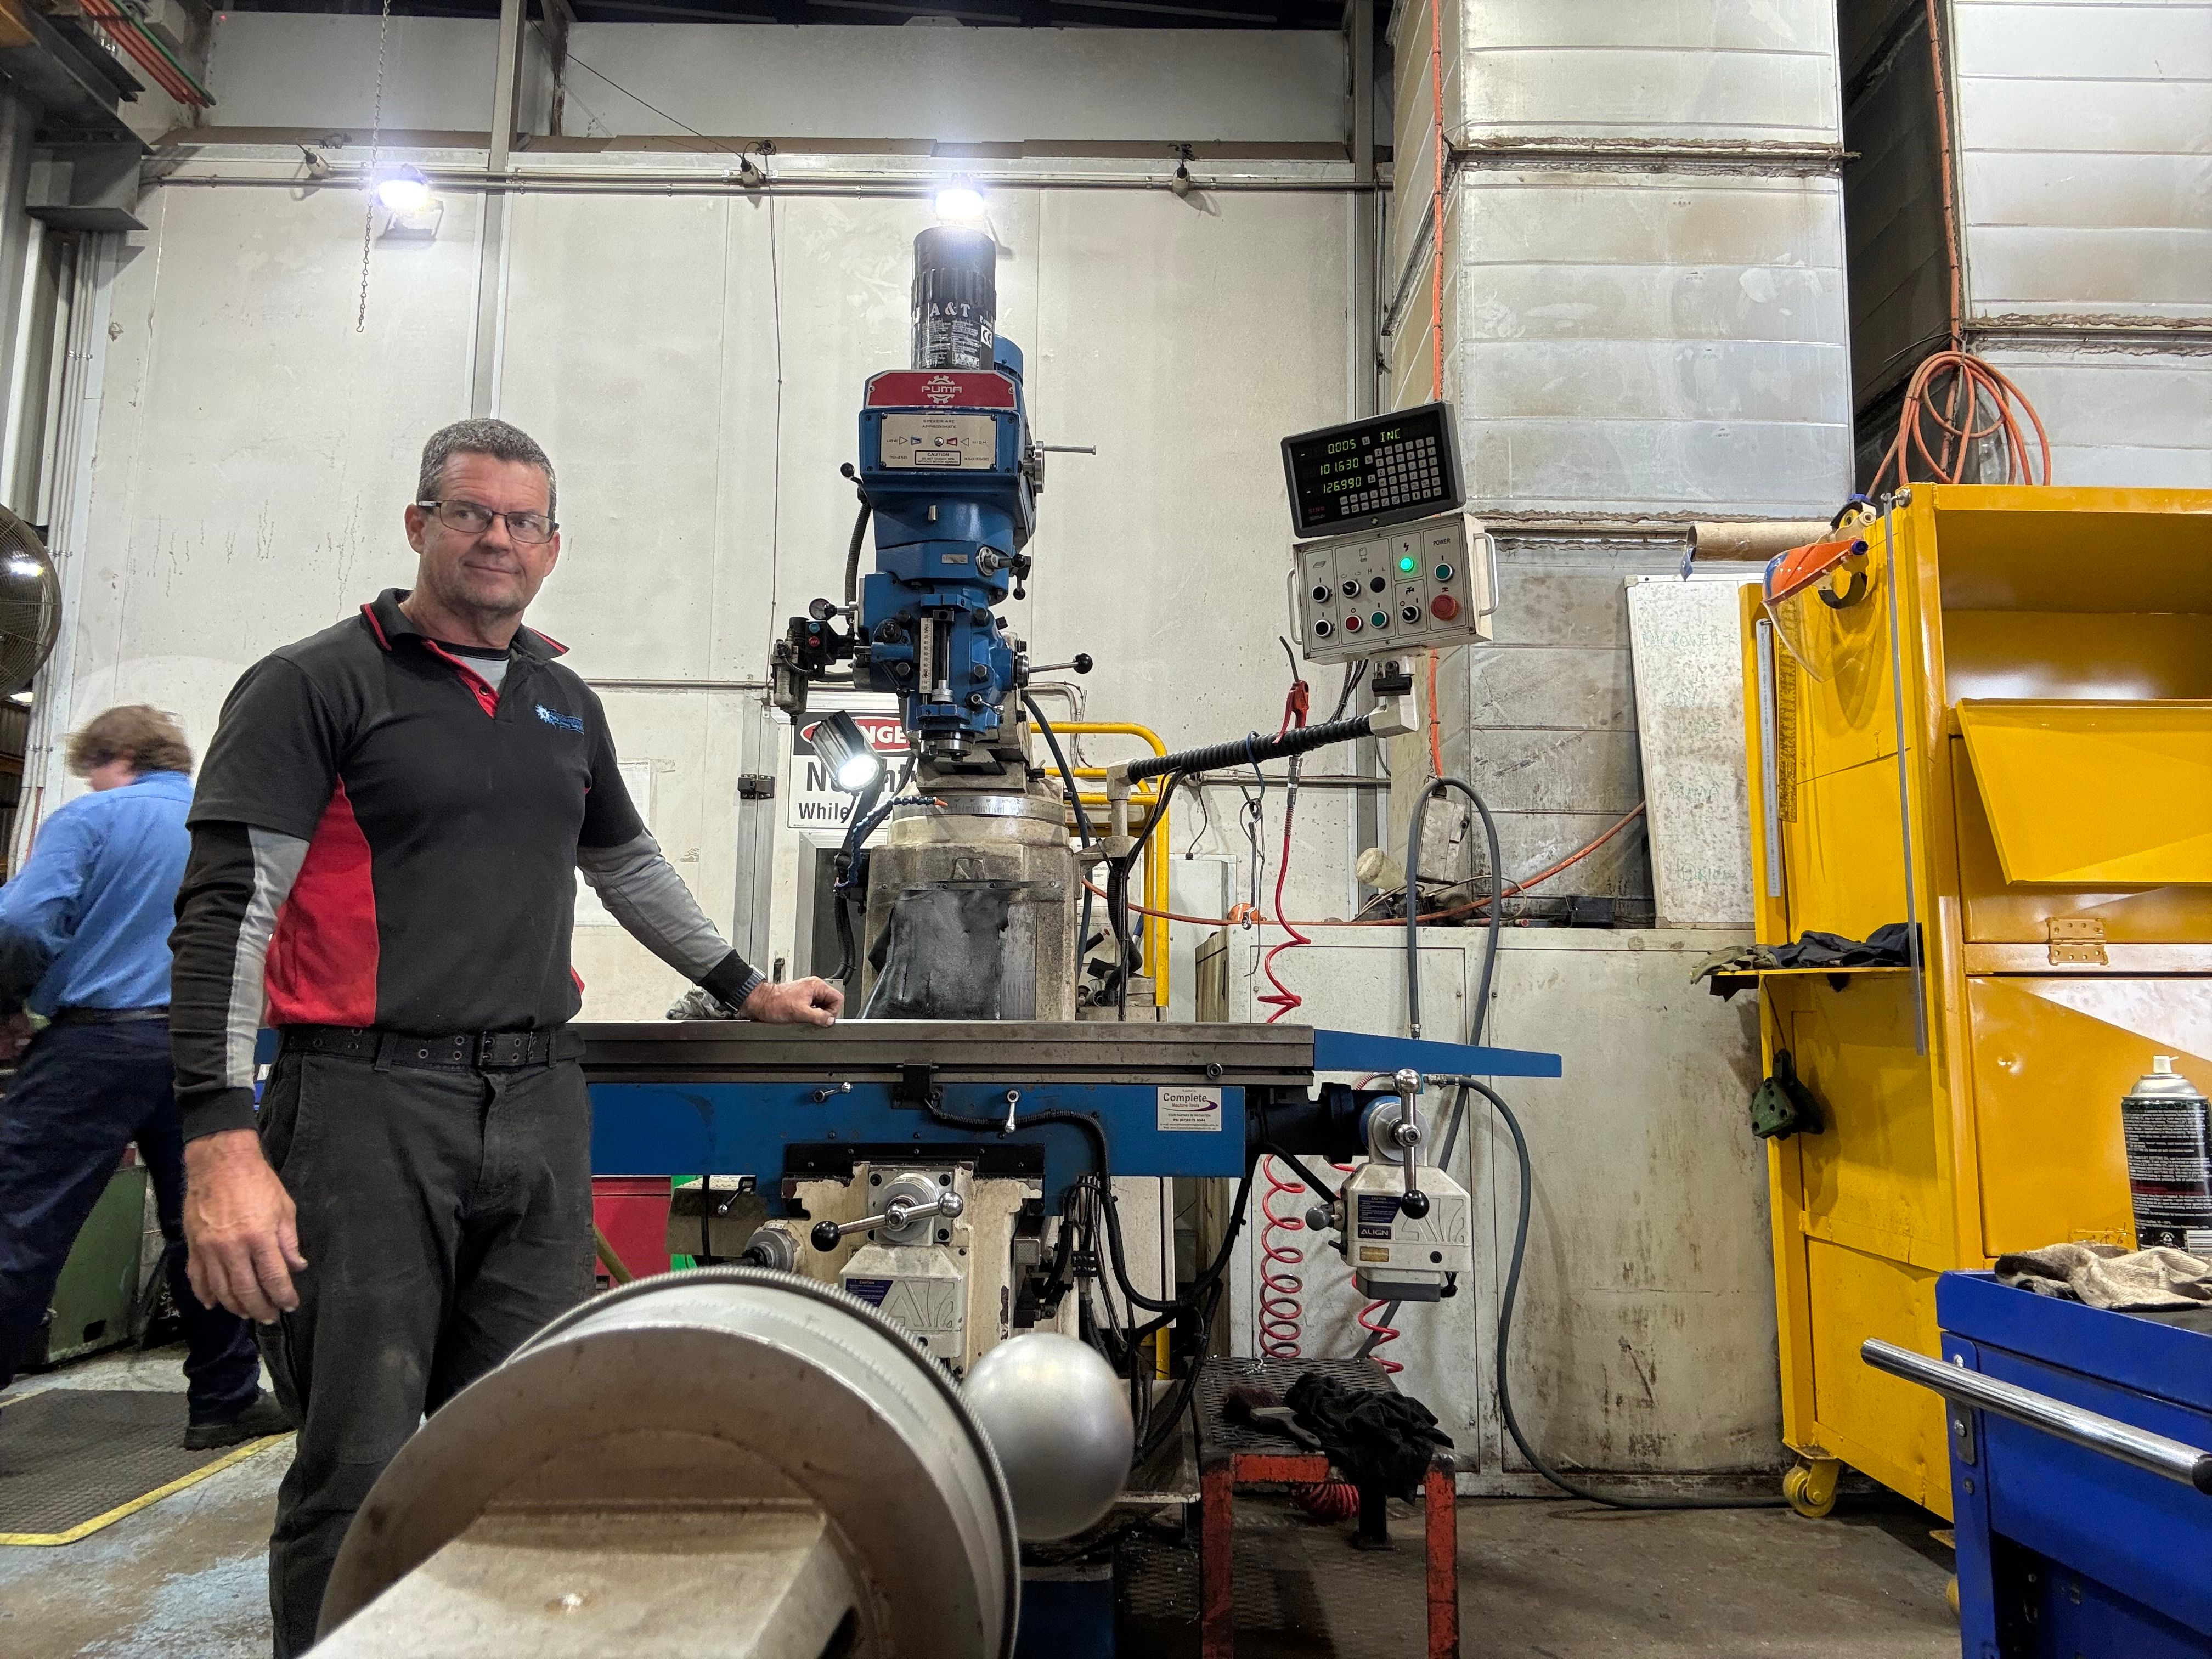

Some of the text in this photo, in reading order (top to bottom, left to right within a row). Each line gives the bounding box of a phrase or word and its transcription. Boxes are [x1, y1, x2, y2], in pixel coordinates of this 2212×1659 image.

[930, 303, 941, 317] A
[945, 302, 957, 315] &
[960, 303, 970, 317] T
[1380, 428, 1401, 442] INC
[1432, 538, 1451, 546] POWER
[798, 802, 849, 820] While
[1163, 1093, 1207, 1103] Complete
